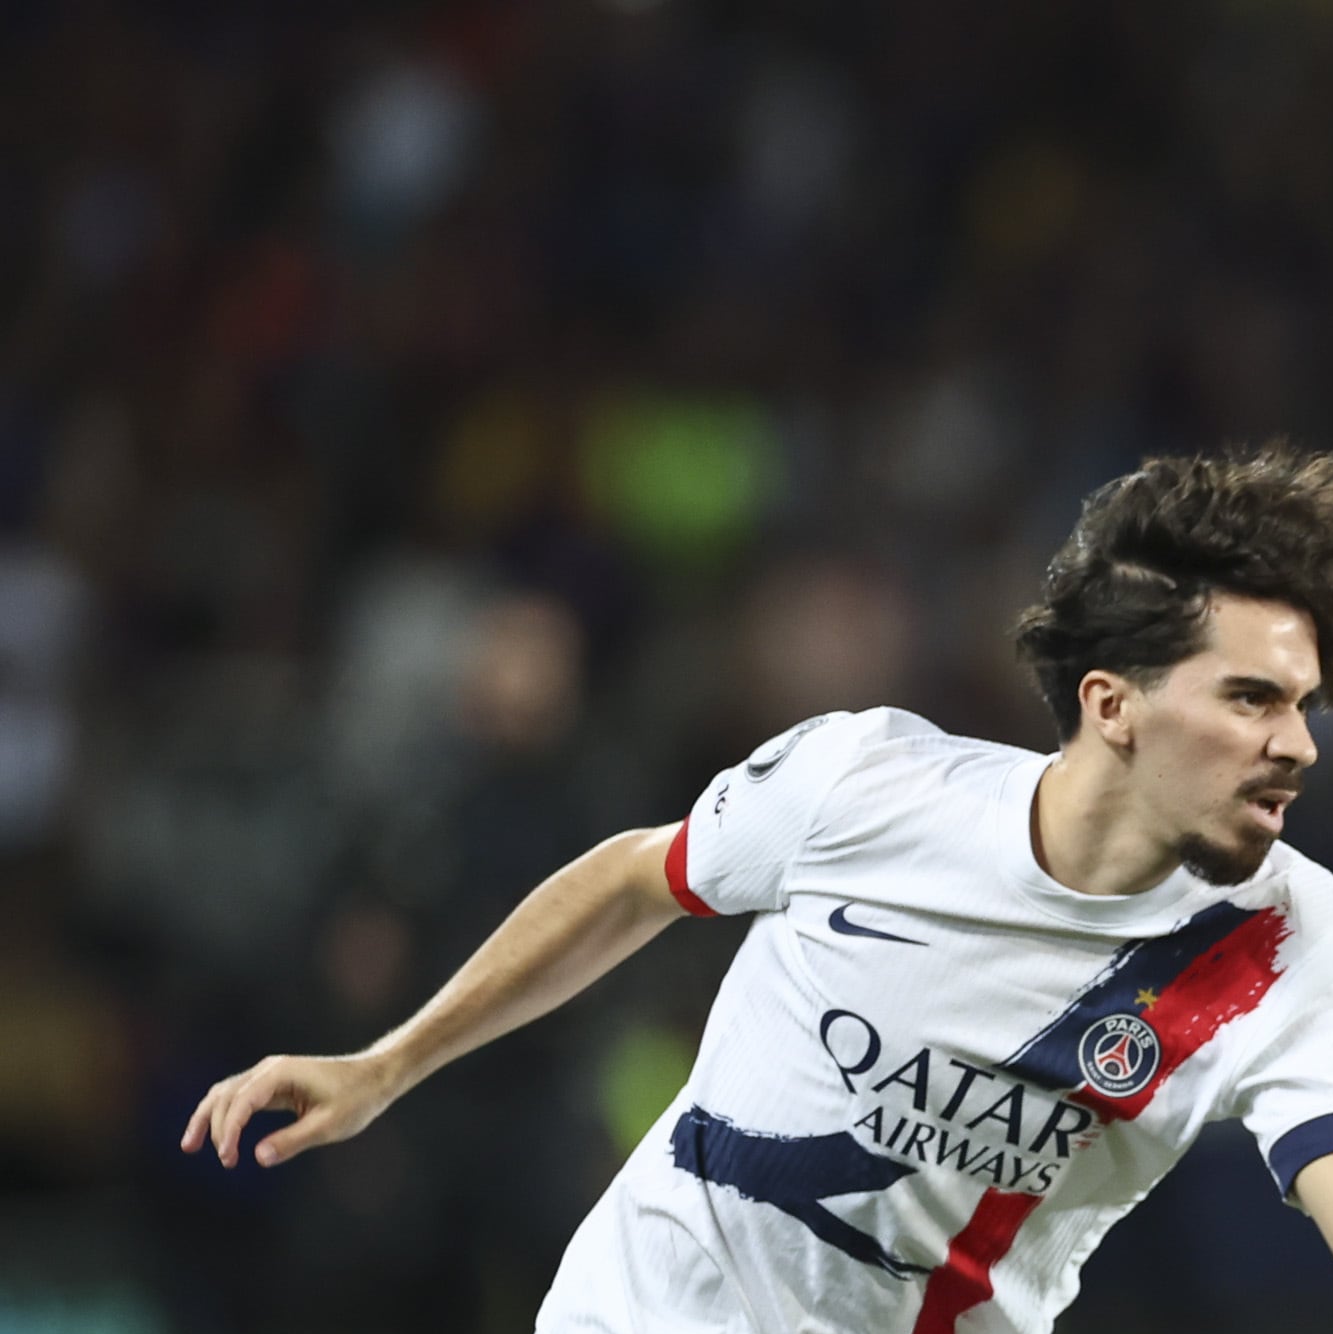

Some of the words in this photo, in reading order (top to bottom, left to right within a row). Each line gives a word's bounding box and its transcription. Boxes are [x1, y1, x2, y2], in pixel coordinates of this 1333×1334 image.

[1105, 1018, 1154, 1049] PARIS
[820, 1008, 1092, 1158] QATAR
[853, 1105, 1061, 1192] AIRWAYS
